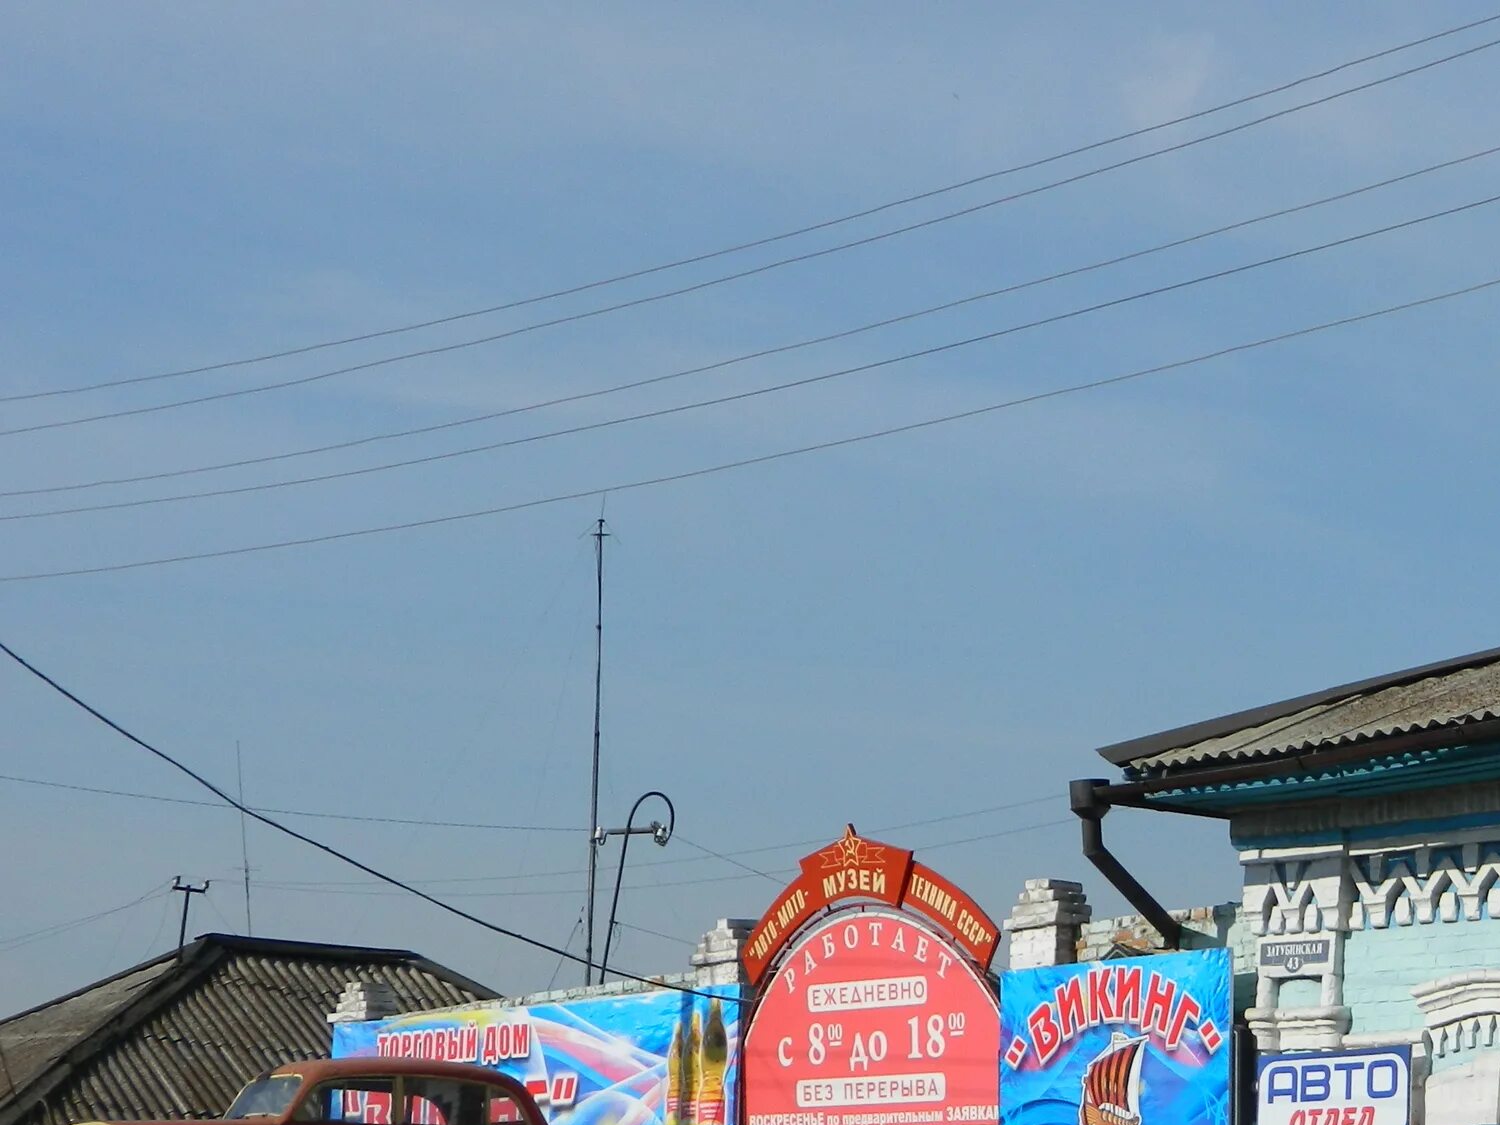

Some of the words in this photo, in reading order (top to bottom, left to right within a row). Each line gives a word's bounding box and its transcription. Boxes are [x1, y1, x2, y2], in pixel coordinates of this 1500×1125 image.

[822, 868, 886, 899] МУЗЕЙ
[910, 873, 956, 922] ТЕХНИКА
[783, 922, 953, 994] РАБОТАЕТ
[1266, 942, 1322, 958] ЗАТУБИНСКАЯ
[1286, 957, 1300, 970] 43
[812, 980, 925, 1006] ЕЖЕДНЕВНО
[1004, 964, 1223, 1071] "ВИКИНГ"
[377, 1019, 479, 1062] ТОРГОВЫЙ
[481, 1023, 531, 1066] ДОМ
[802, 1084, 834, 1102] БЕЗ
[844, 1078, 939, 1100] ПЕРЕРЫВА
[1267, 1059, 1399, 1104] АВТО
